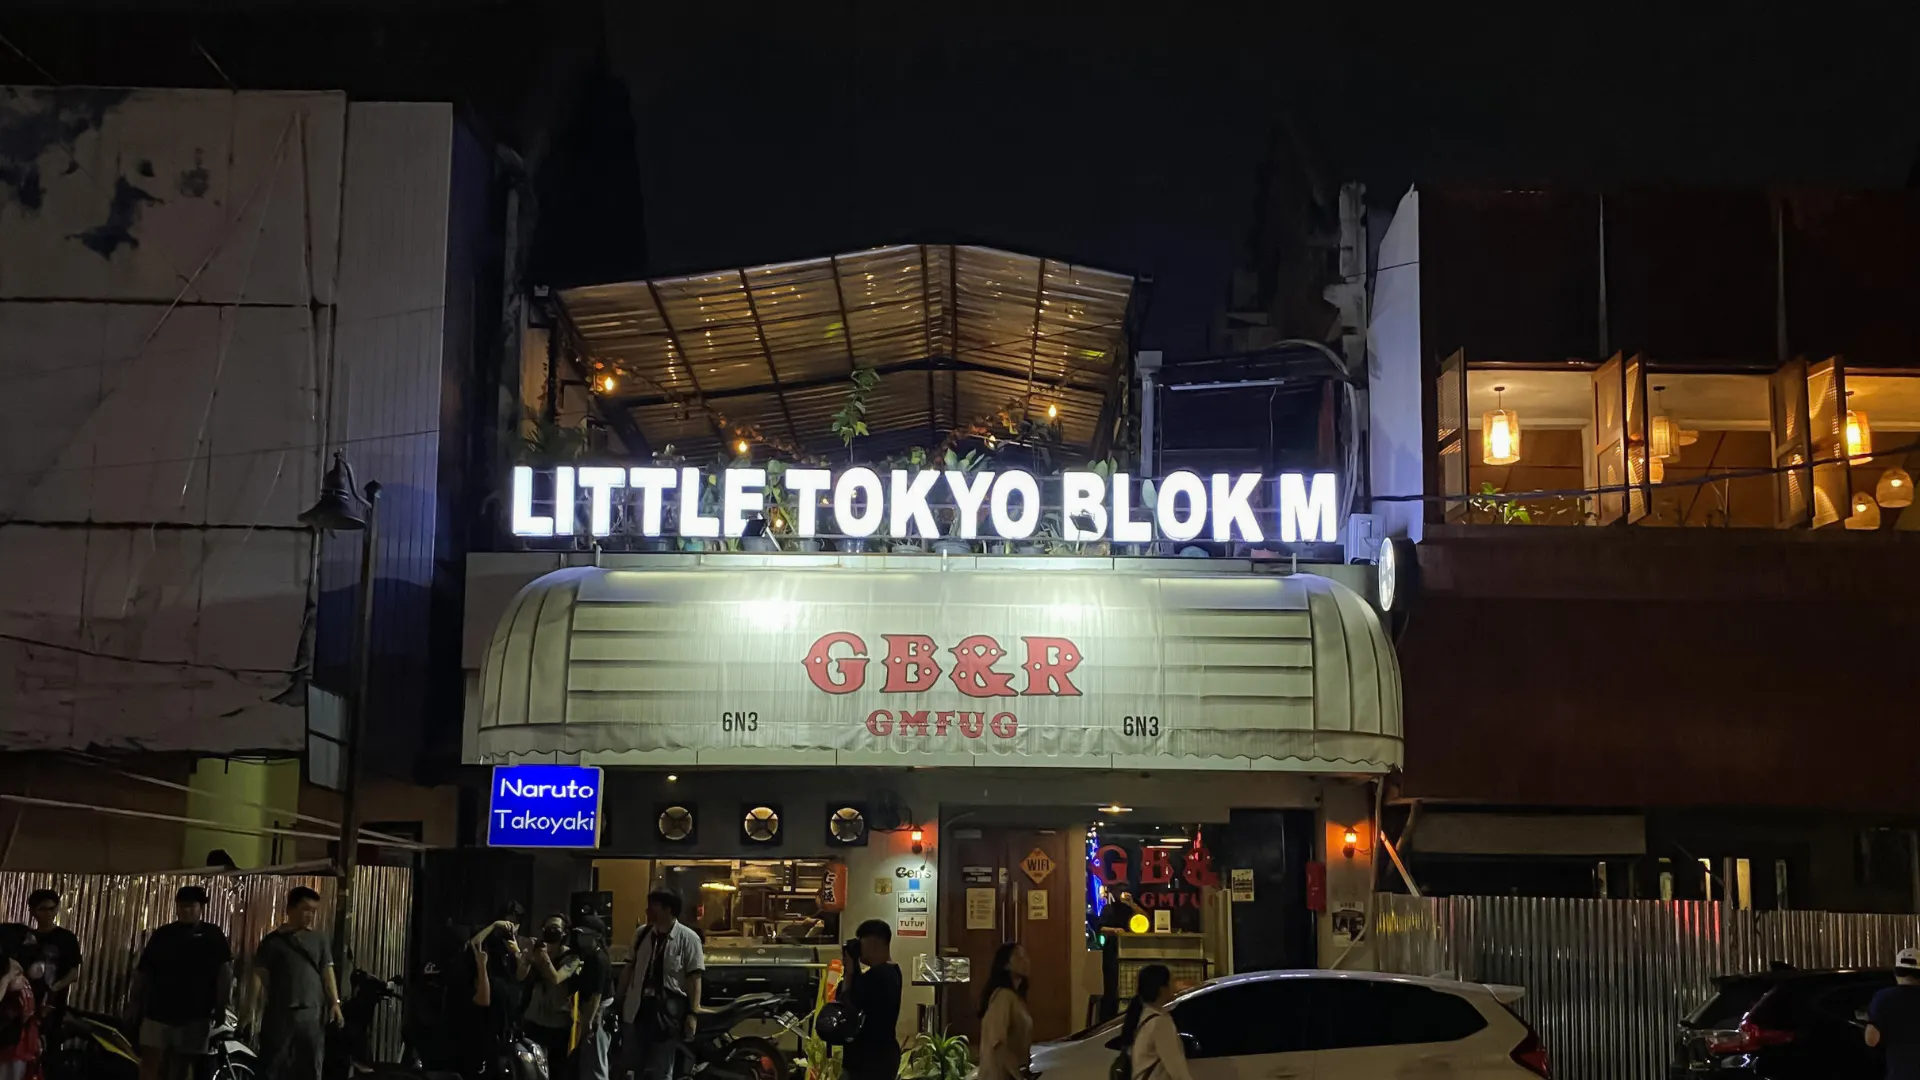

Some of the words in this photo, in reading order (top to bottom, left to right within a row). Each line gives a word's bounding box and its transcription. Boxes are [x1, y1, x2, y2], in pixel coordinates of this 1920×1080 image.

[512, 466, 766, 538] LITTLE
[785, 466, 1040, 540] TOKYO
[1063, 470, 1264, 542] BLOK
[1280, 472, 1337, 543] M
[801, 631, 1085, 698] GB&R
[721, 711, 759, 733] 6N3
[865, 709, 1019, 739] GMFUG
[1122, 715, 1160, 738] 6N3
[500, 777, 595, 799] Naruto
[493, 809, 595, 835] Takoyaki
[1027, 859, 1051, 871] WIFI
[899, 896, 926, 904] BUKA
